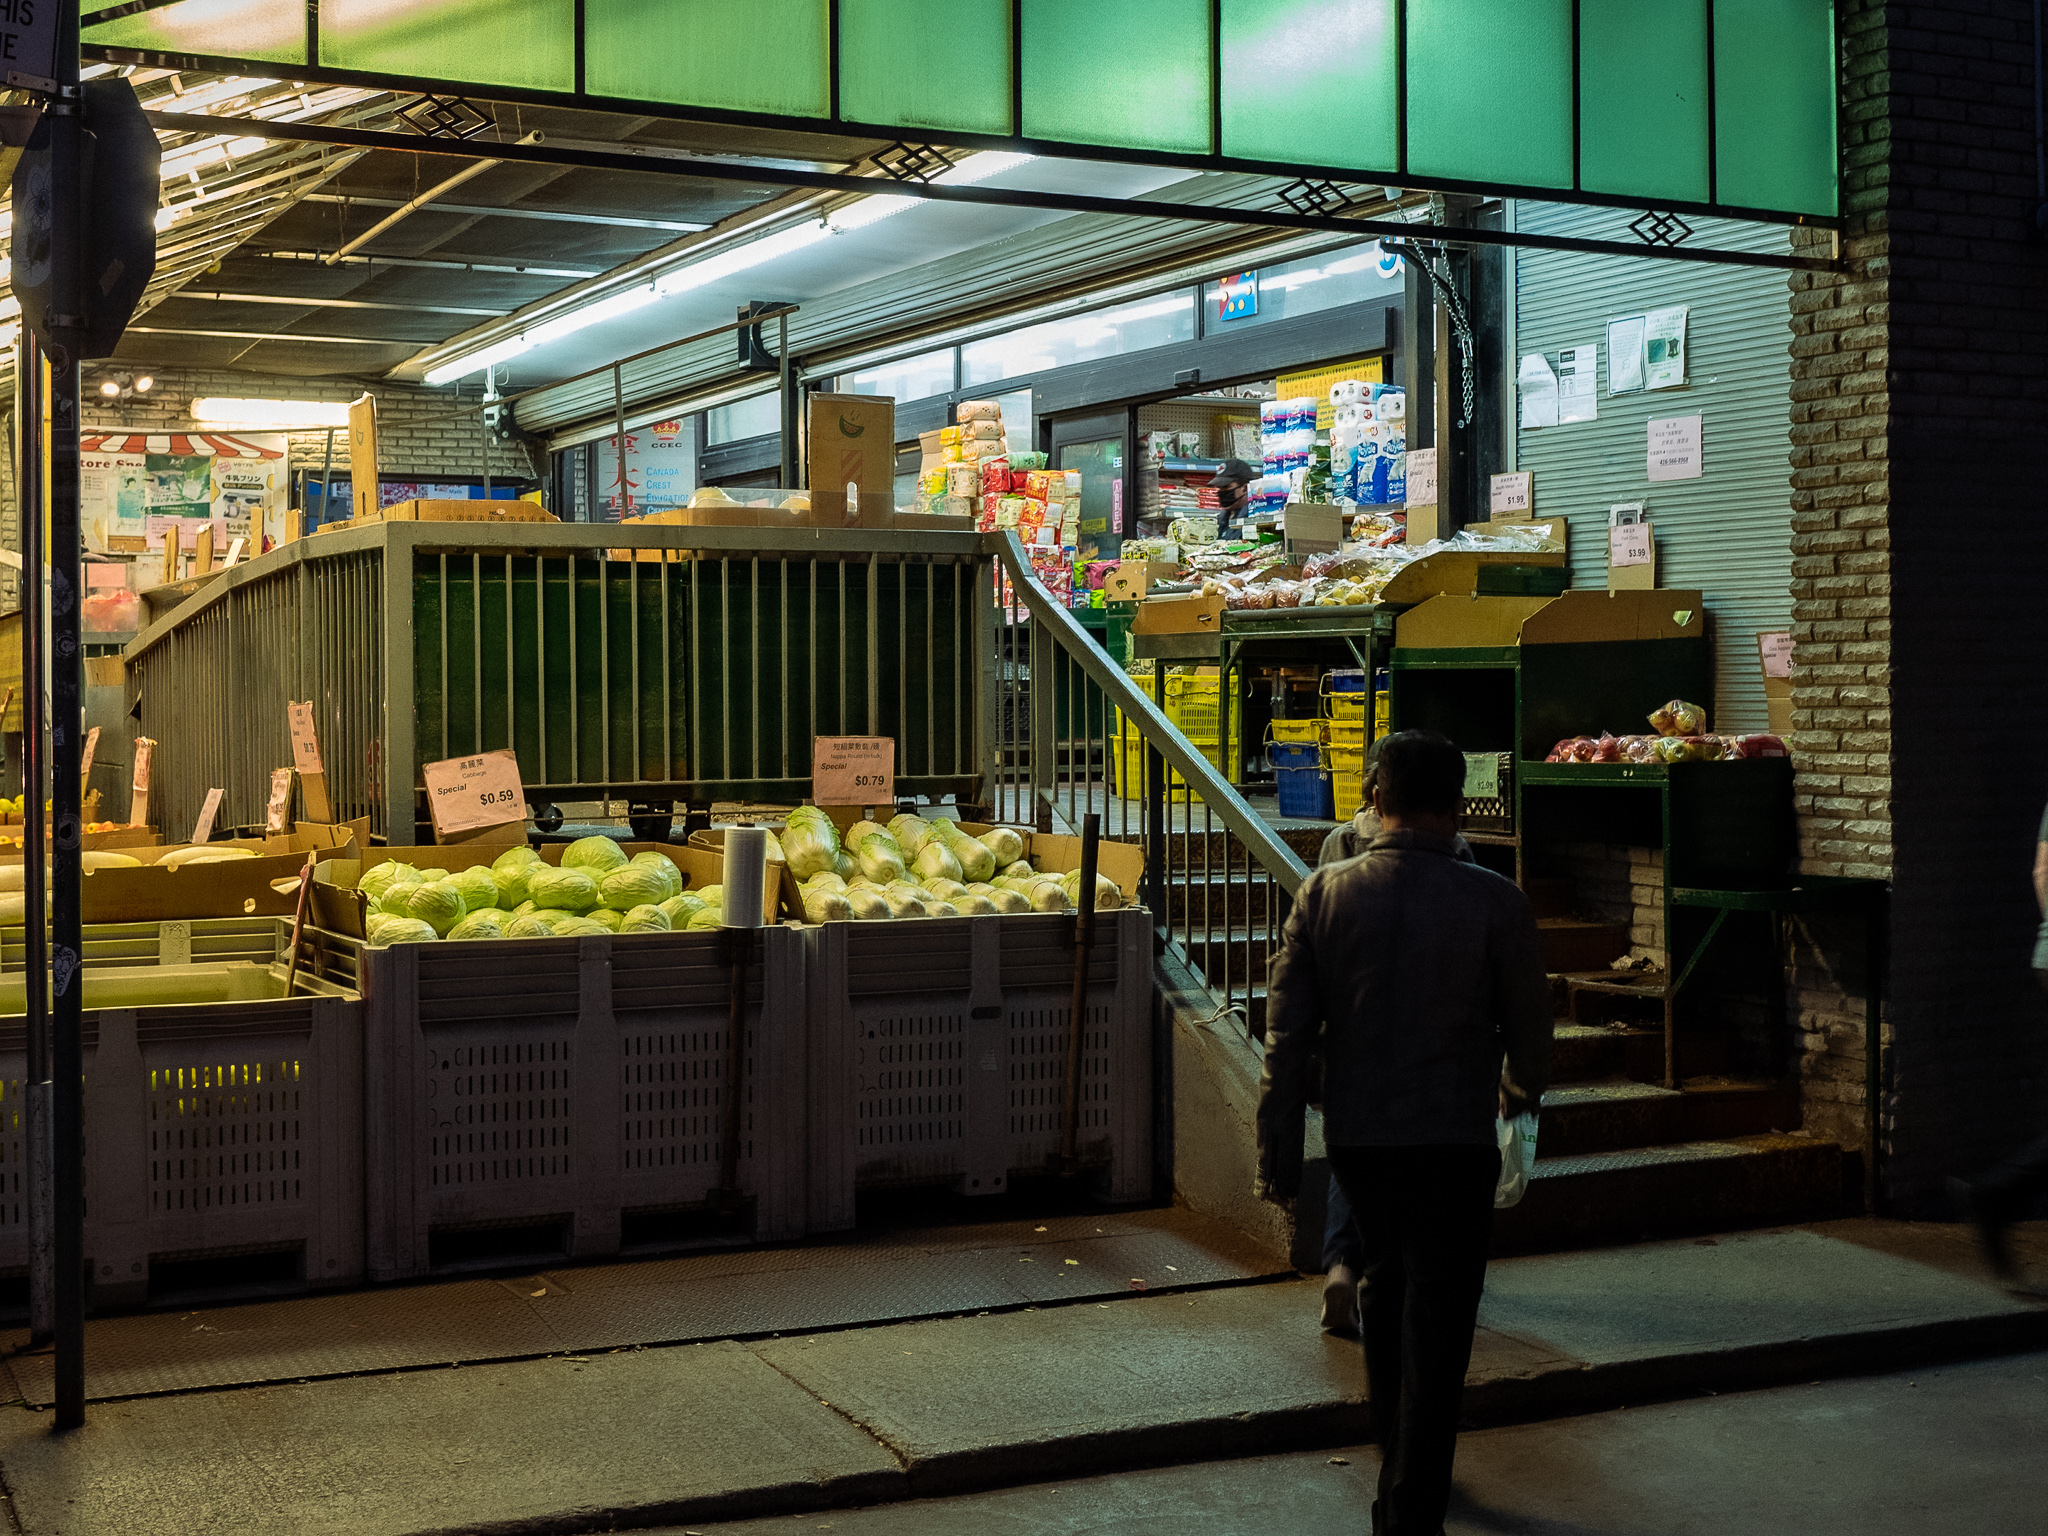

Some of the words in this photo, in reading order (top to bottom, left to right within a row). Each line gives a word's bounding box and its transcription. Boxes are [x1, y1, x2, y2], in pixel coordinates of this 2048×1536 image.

[80, 459, 110, 468] tore
[646, 467, 679, 476] CANADA
[646, 480, 671, 489] CREST
[1508, 495, 1524, 505] $1.99
[1629, 549, 1646, 557] $3.99
[821, 763, 847, 771] Special
[462, 770, 487, 779] Cabbage
[855, 775, 885, 786] $0.79
[437, 783, 467, 796] Special
[480, 789, 514, 806] $0.59
